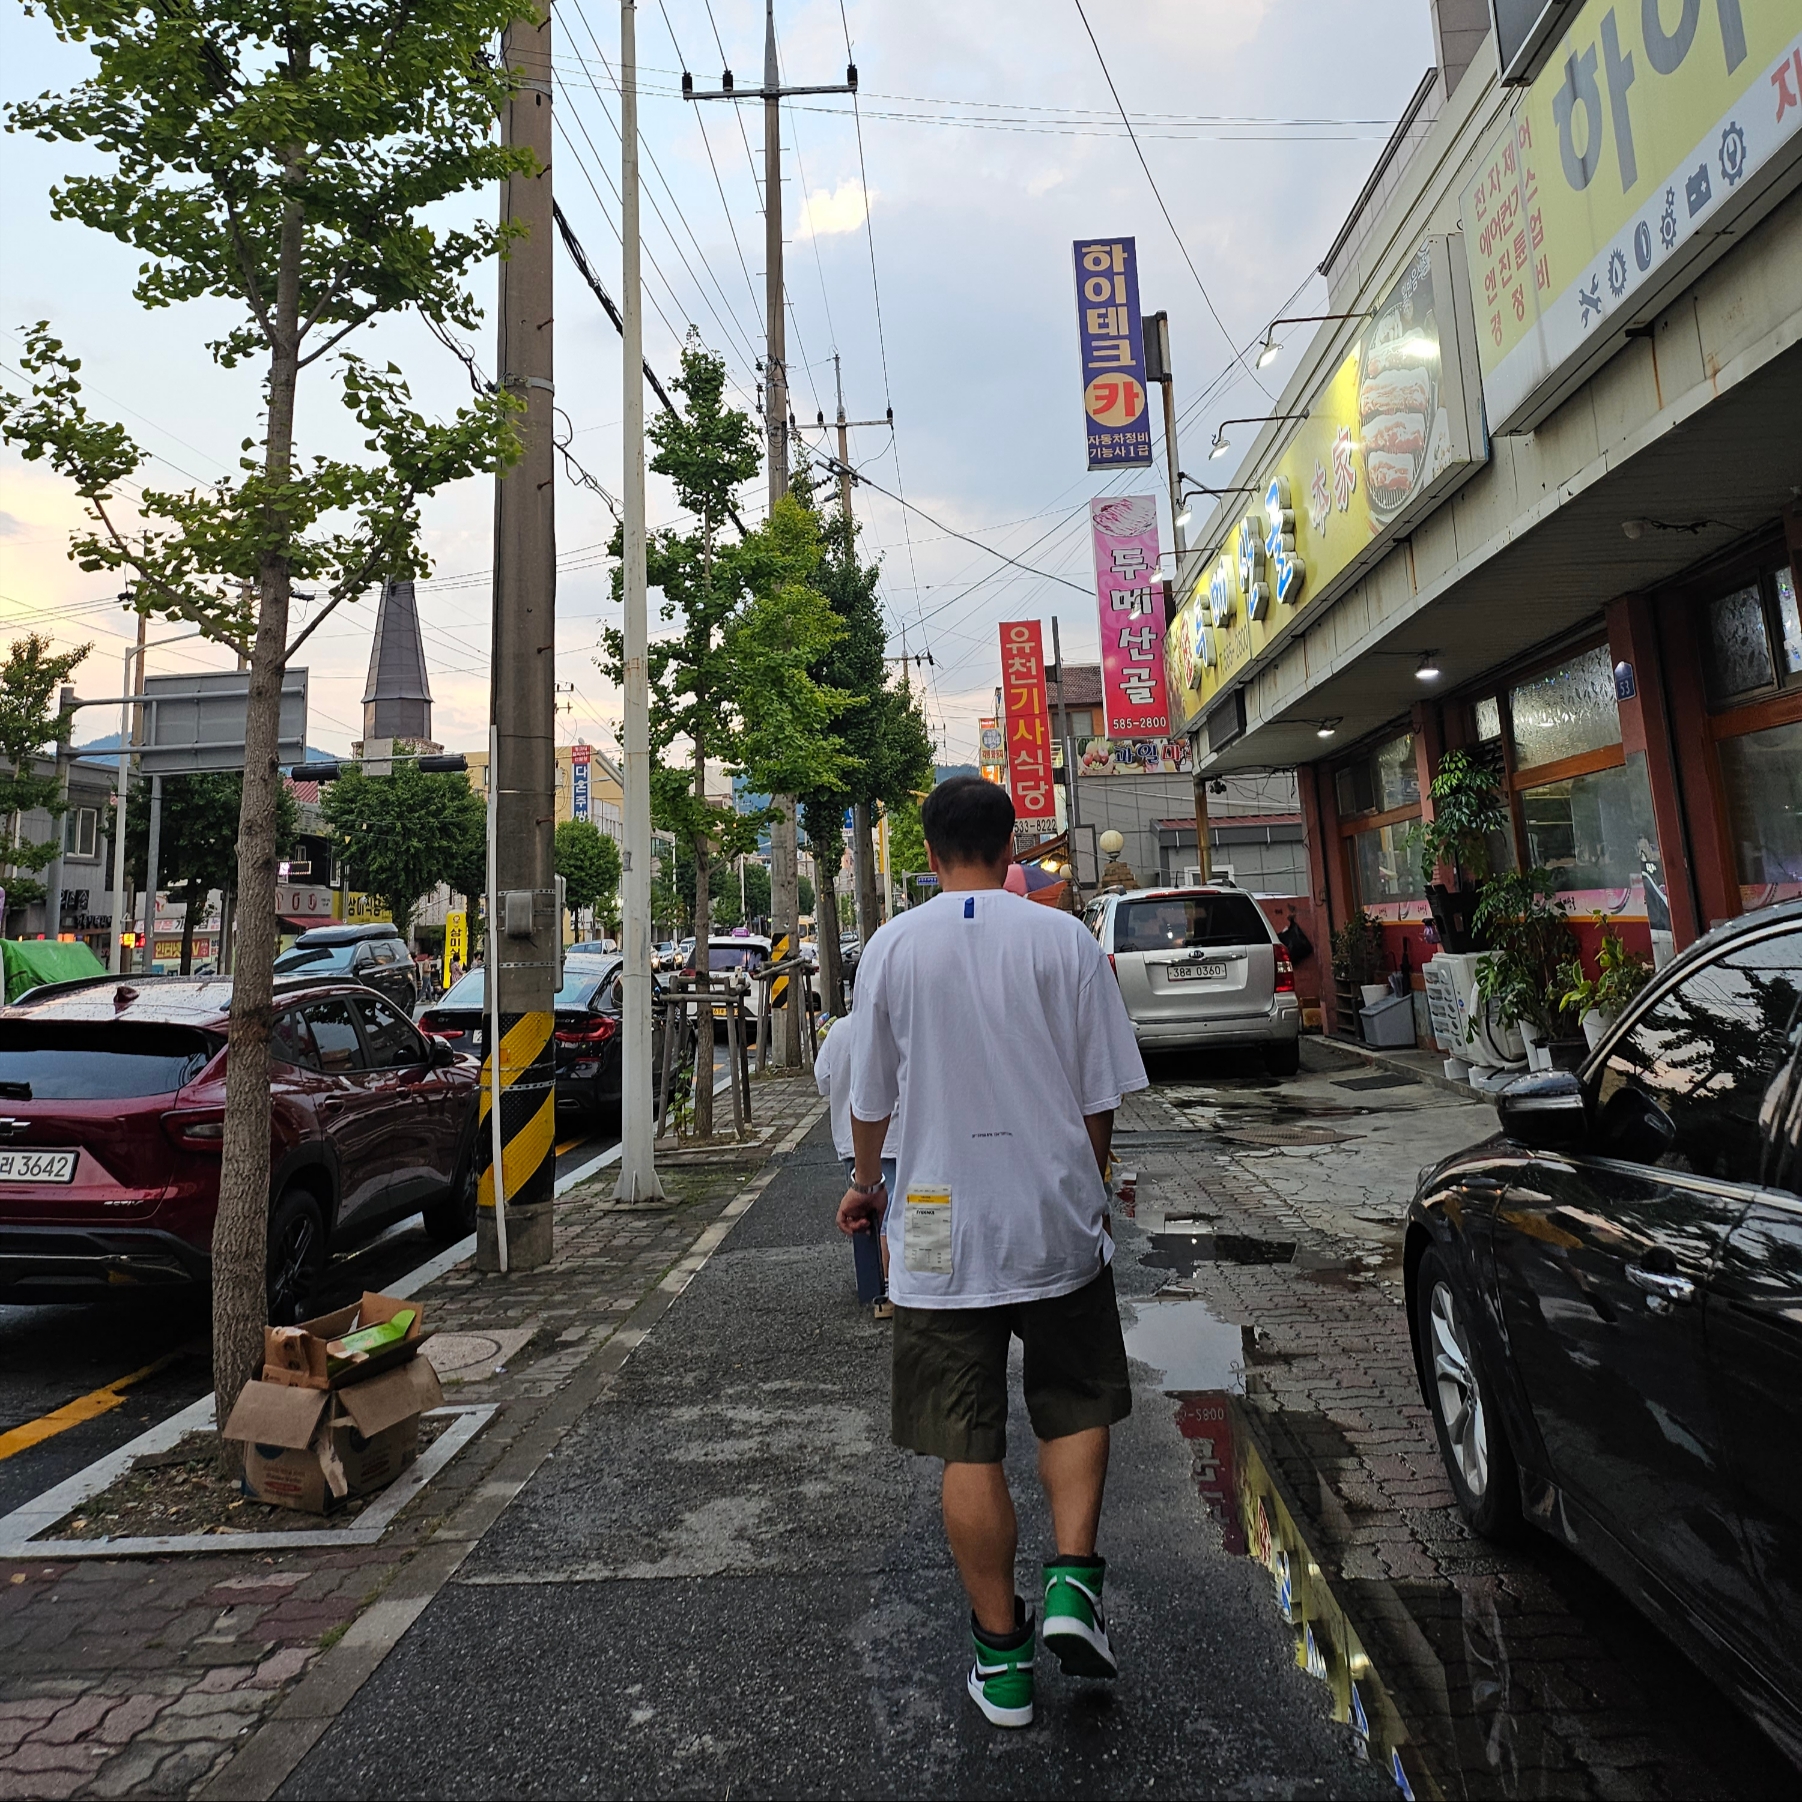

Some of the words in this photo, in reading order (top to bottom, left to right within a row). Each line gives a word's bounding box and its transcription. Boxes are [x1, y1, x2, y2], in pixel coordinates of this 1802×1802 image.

[1474, 116, 1532, 222] 전자제어
[1485, 207, 1544, 306] 엔진튠업
[1088, 432, 1149, 446] 자동차정비
[1089, 446, 1126, 458] 기능사
[1129, 445, 1149, 457] 1급
[1110, 548, 1158, 705] 두메산골
[1619, 680, 1631, 696] 53
[1005, 625, 1049, 811] 유천기사식당
[1113, 716, 1167, 730] 585-2800
[1014, 818, 1057, 833] 533-8222
[1196, 966, 1221, 976] 0360
[18, 1155, 68, 1177] 3642
